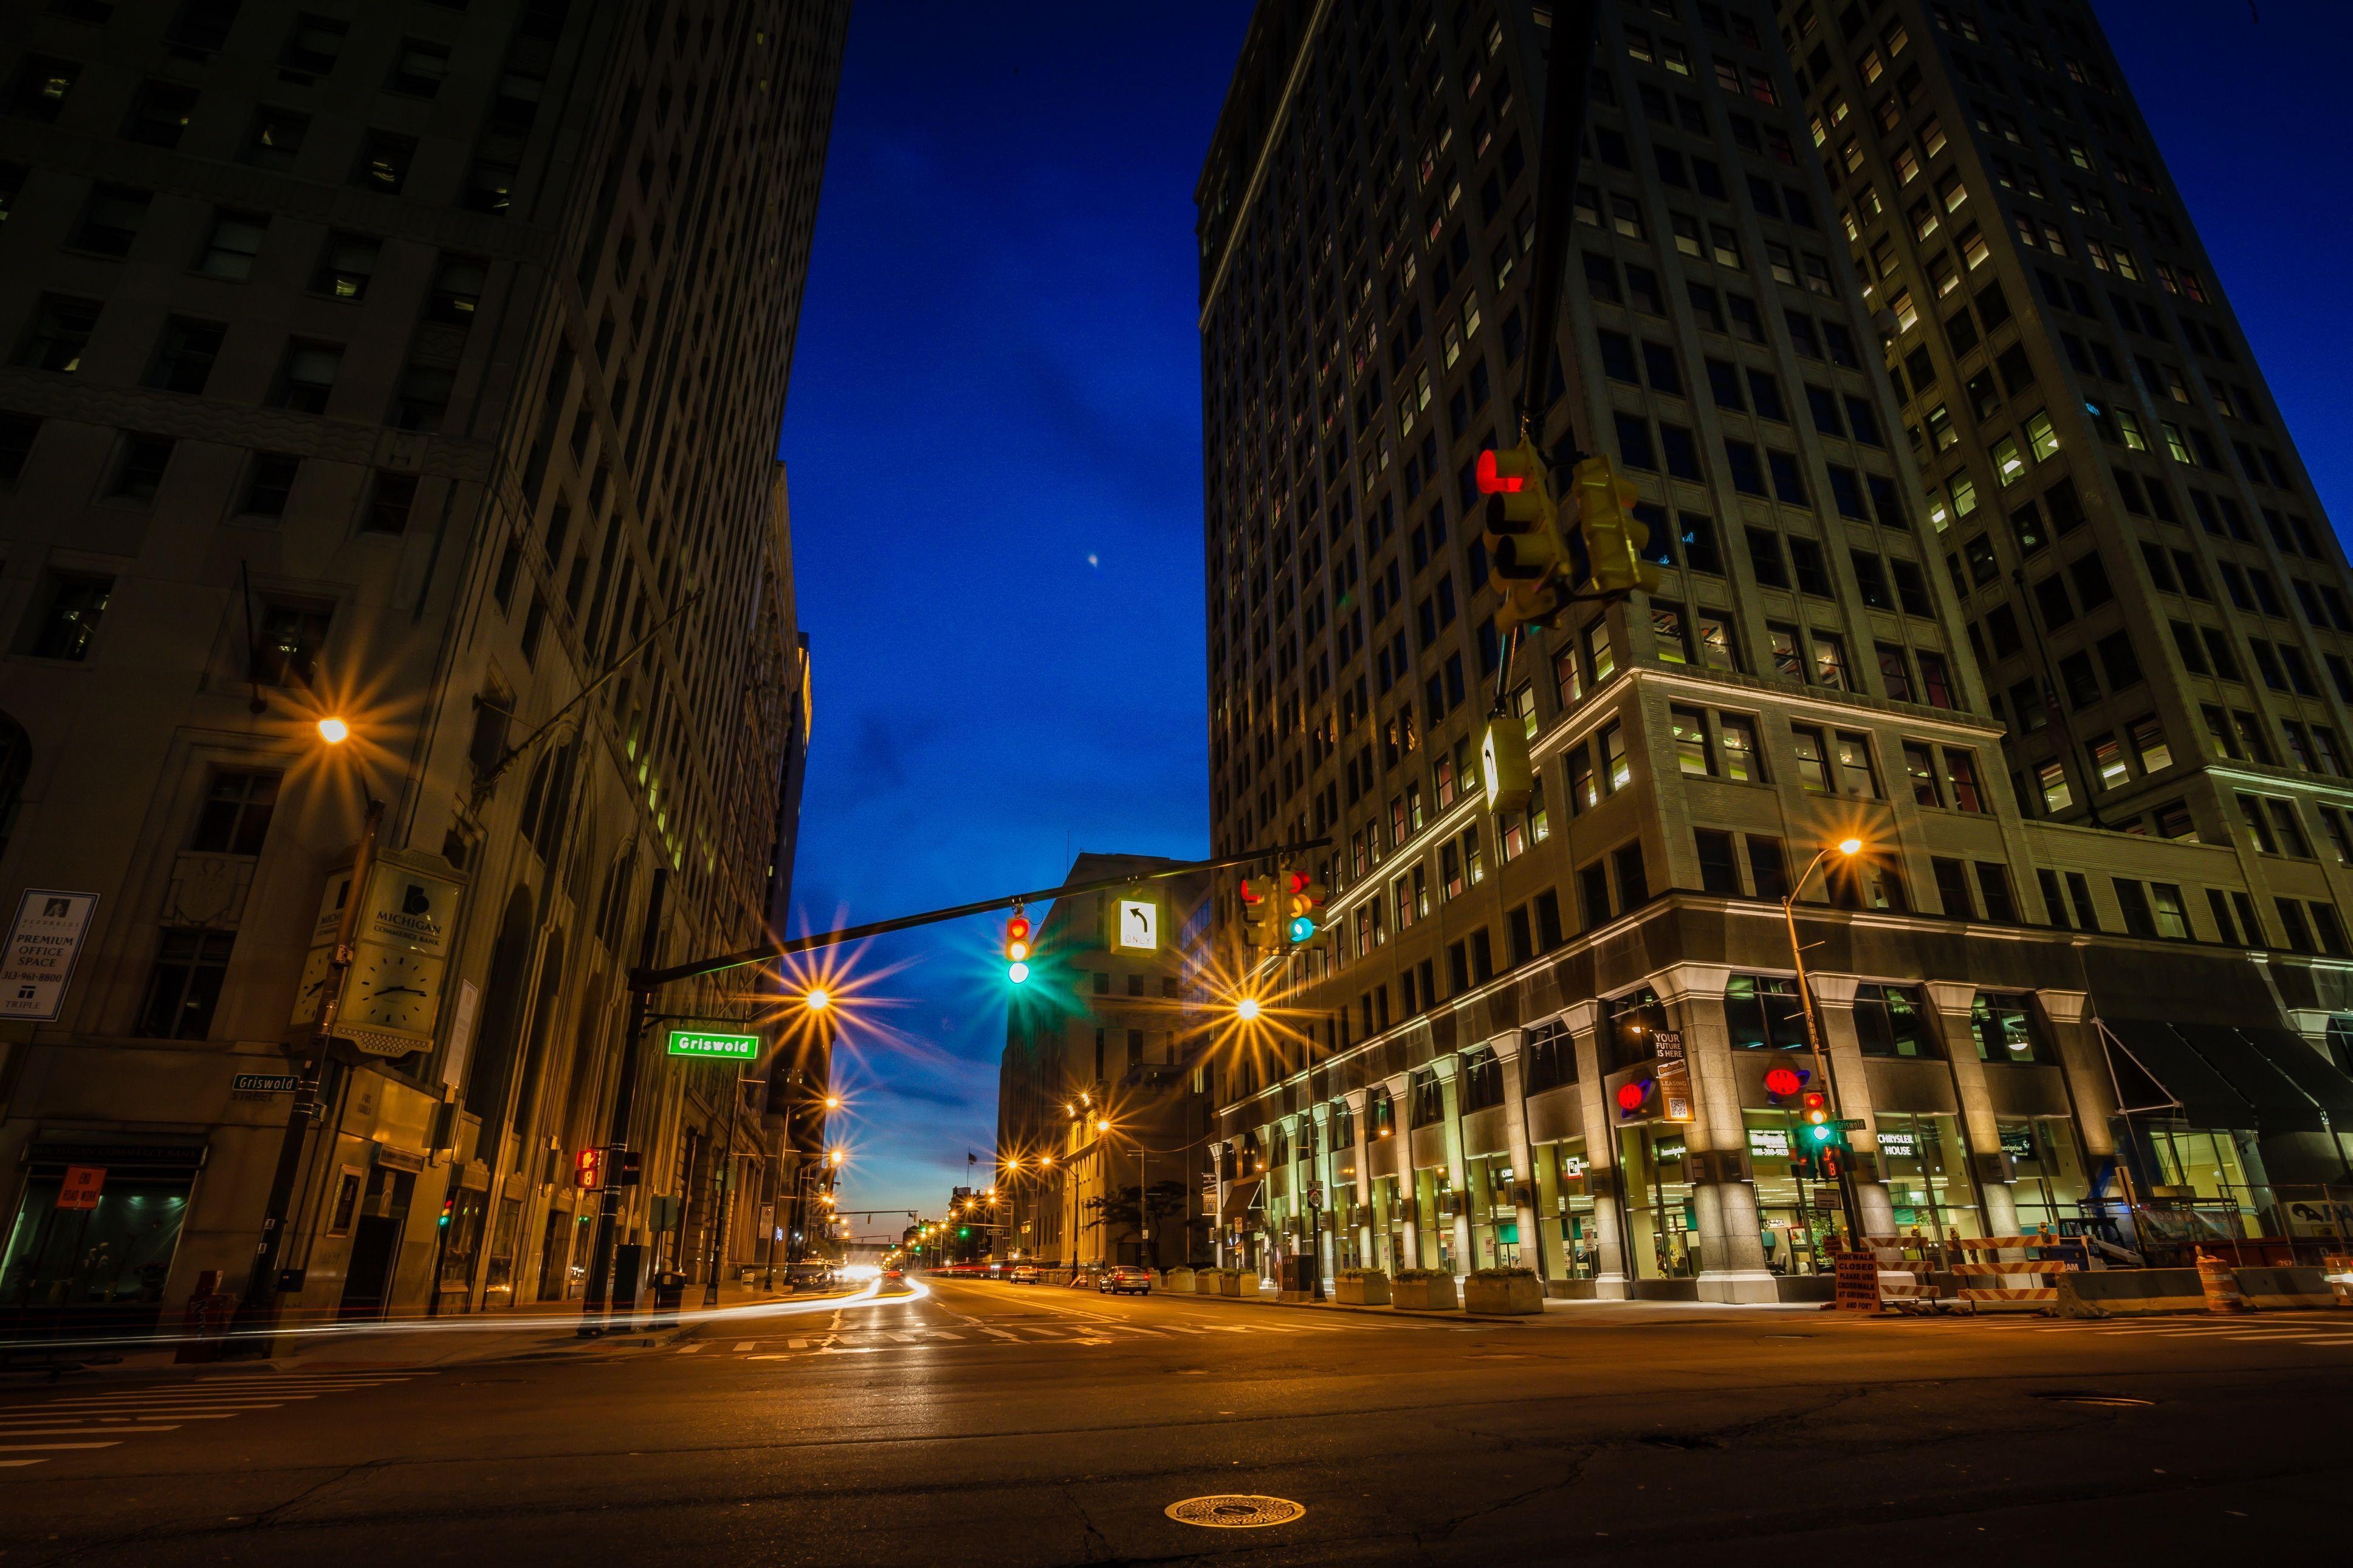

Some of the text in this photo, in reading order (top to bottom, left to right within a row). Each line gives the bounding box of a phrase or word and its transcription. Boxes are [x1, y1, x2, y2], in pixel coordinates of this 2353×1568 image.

[321, 912, 342, 925] MICHI
[376, 911, 442, 934] MICHIGAN
[16, 934, 74, 946] PREMIUM
[374, 925, 439, 946] COMMERCE BANK
[1125, 934, 1151, 945] ONLY
[19, 946, 64, 956] OFFICE
[18, 957, 57, 967] SPACE
[2, 971, 61, 982] 313-961-8800
[5, 1001, 41, 1009] TRIPLE
[1654, 1033, 1680, 1042] YOUR
[679, 1036, 749, 1053] Griswold
[1659, 1061, 1685, 1074] Bedrock
[239, 1076, 295, 1090] Griswold
[1838, 1120, 1864, 1130] Griswold
[1877, 1134, 1914, 1143] CHRYSLER
[1884, 1146, 1912, 1155] HOUSE
[1838, 1282, 1875, 1290] CROSSWALK
[1846, 1292, 1876, 1300] GRISWOLD
